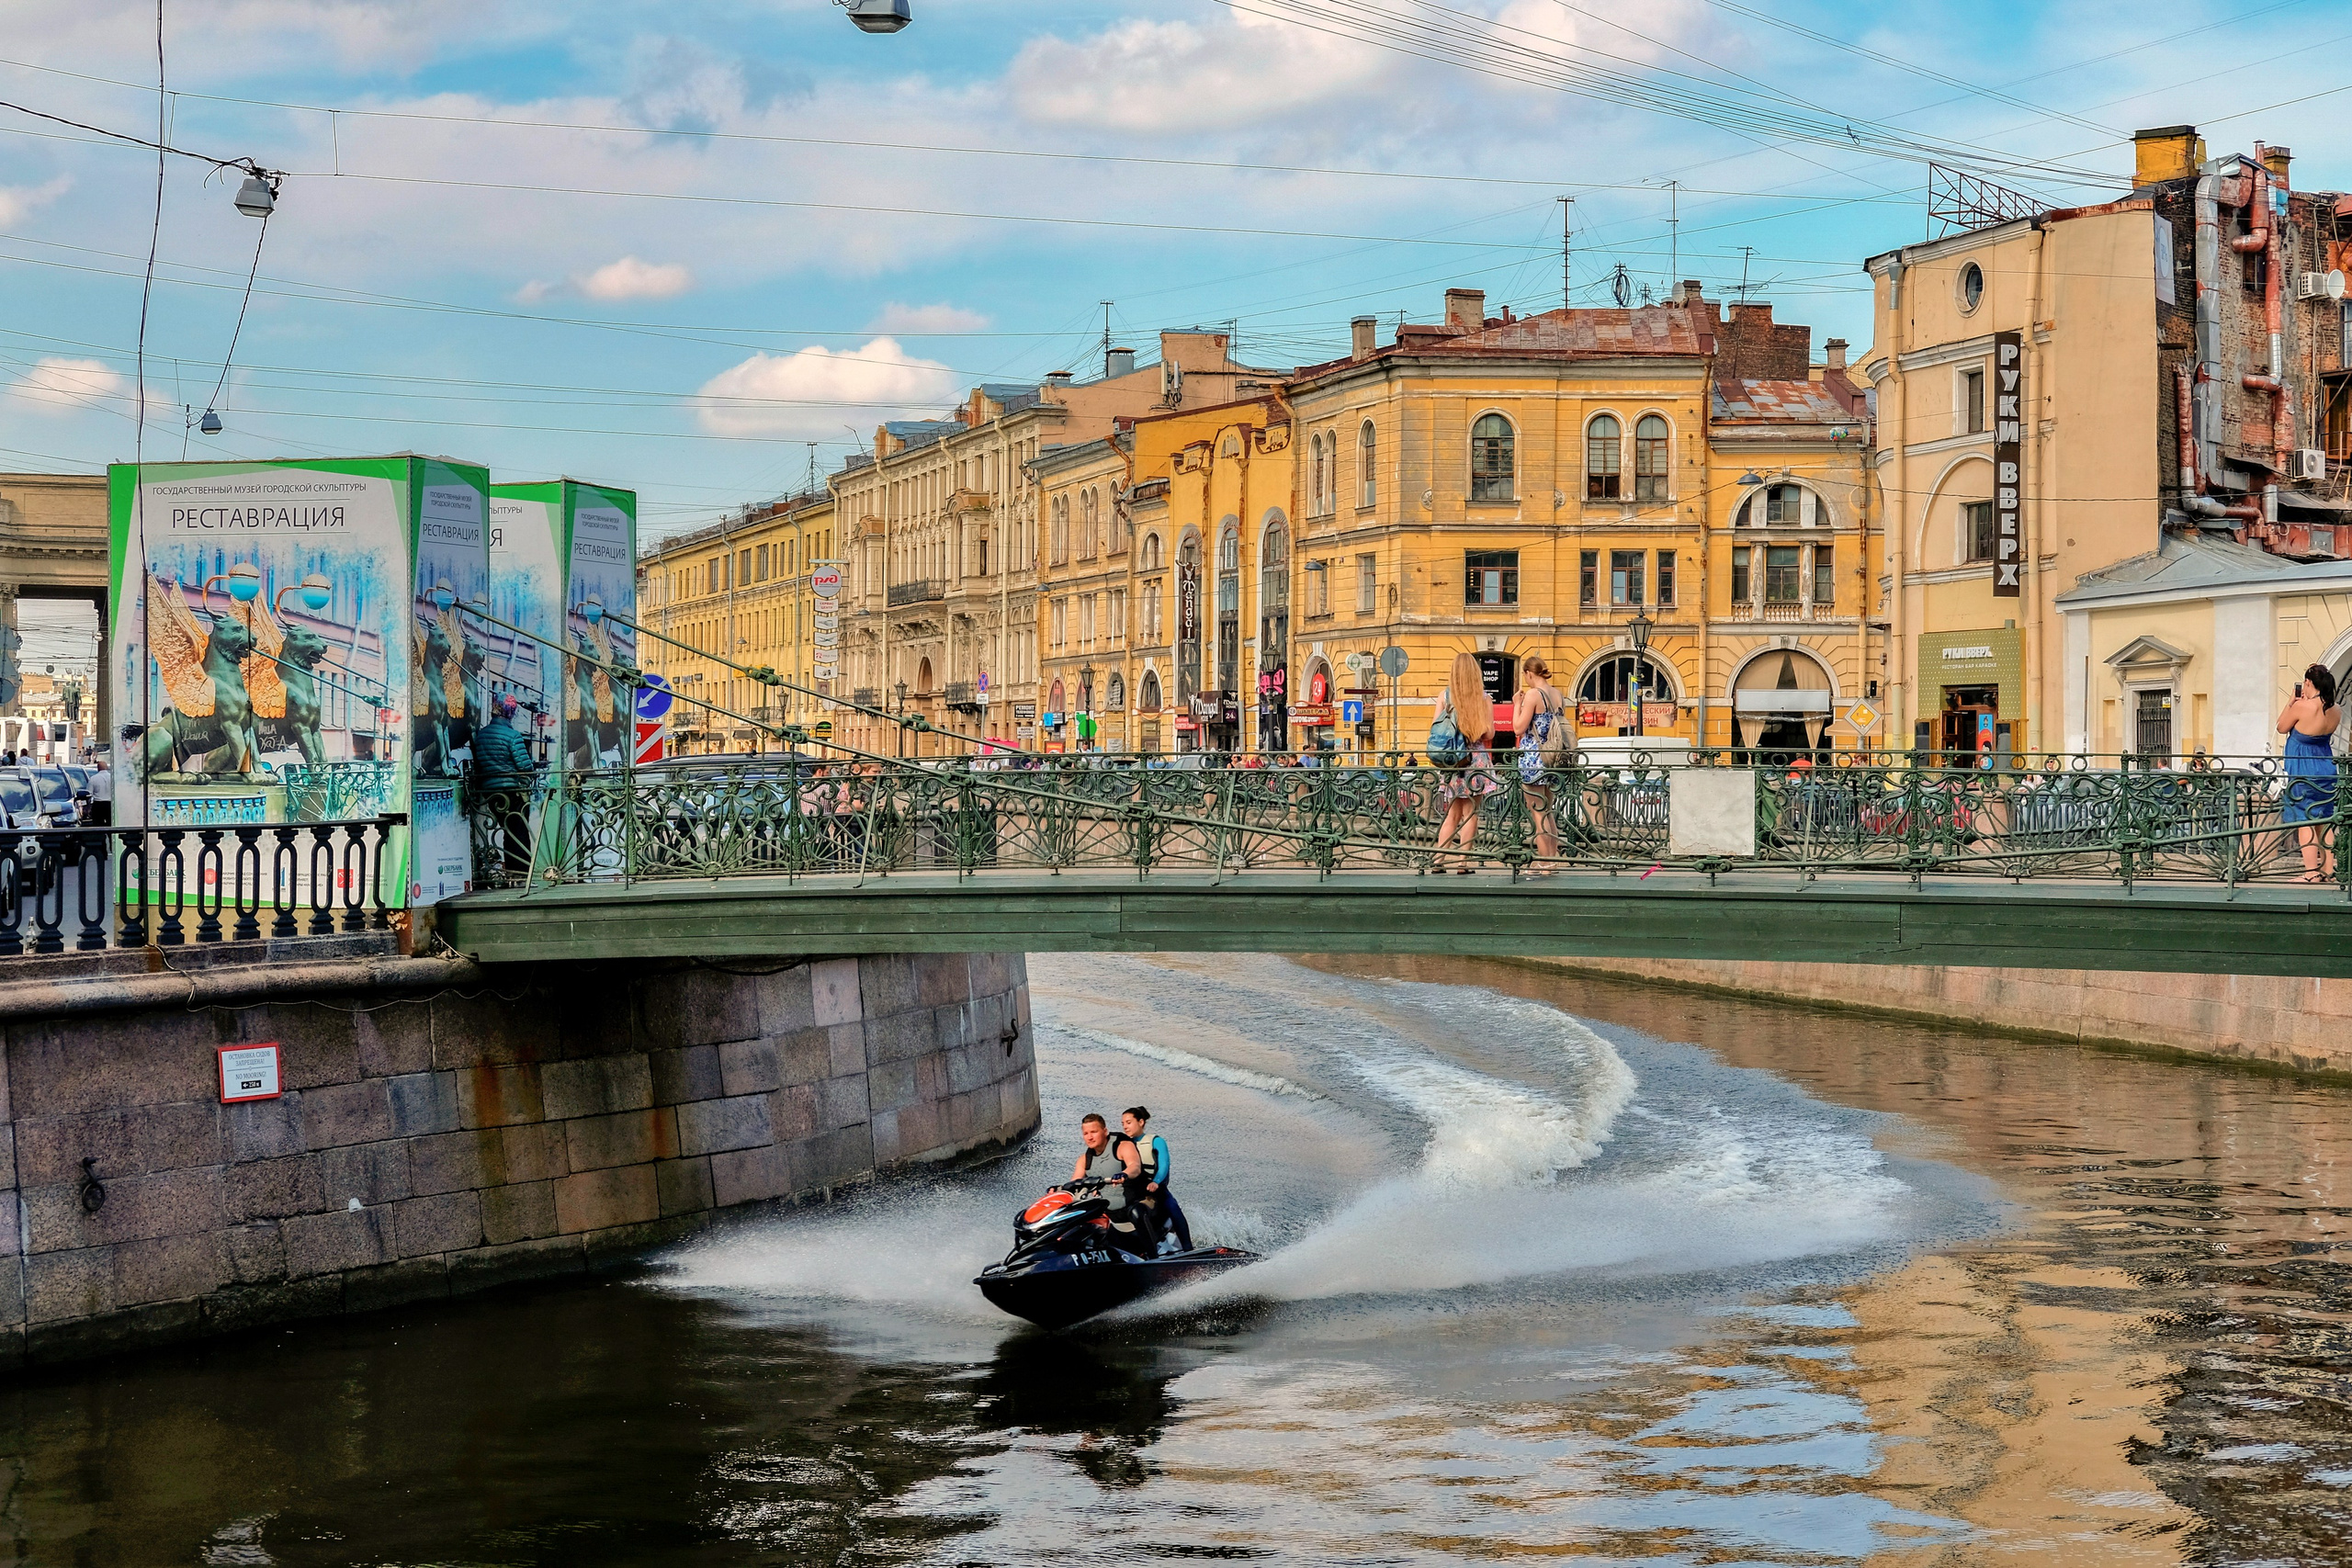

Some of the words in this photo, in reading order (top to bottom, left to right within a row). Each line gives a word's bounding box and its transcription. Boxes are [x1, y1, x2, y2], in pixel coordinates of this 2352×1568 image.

[1998, 344, 2019, 443] РУКИ
[153, 484, 232, 496] ГОСУДАРСТВЕННЫЙ
[233, 483, 262, 494] МУЗЕЙ
[263, 482, 312, 493] ГОРОДСКОЙ
[314, 482, 367, 492] СКУЛЬПТУРЫ
[172, 506, 345, 531] РЕСТАВРАЦИЯ
[490, 506, 523, 514] ЛЬПТУРЫ
[423, 523, 479, 543] РЕСТАВРАЦИЯ
[1997, 462, 2018, 586] ВВЕРХ
[574, 542, 626, 560] РЕСТАВРАЦИЯ
[1182, 580, 1196, 638] Mangal
[1195, 697, 1219, 718] Mangal
[1611, 705, 1670, 715] СТУДЕЕСКИЙ
